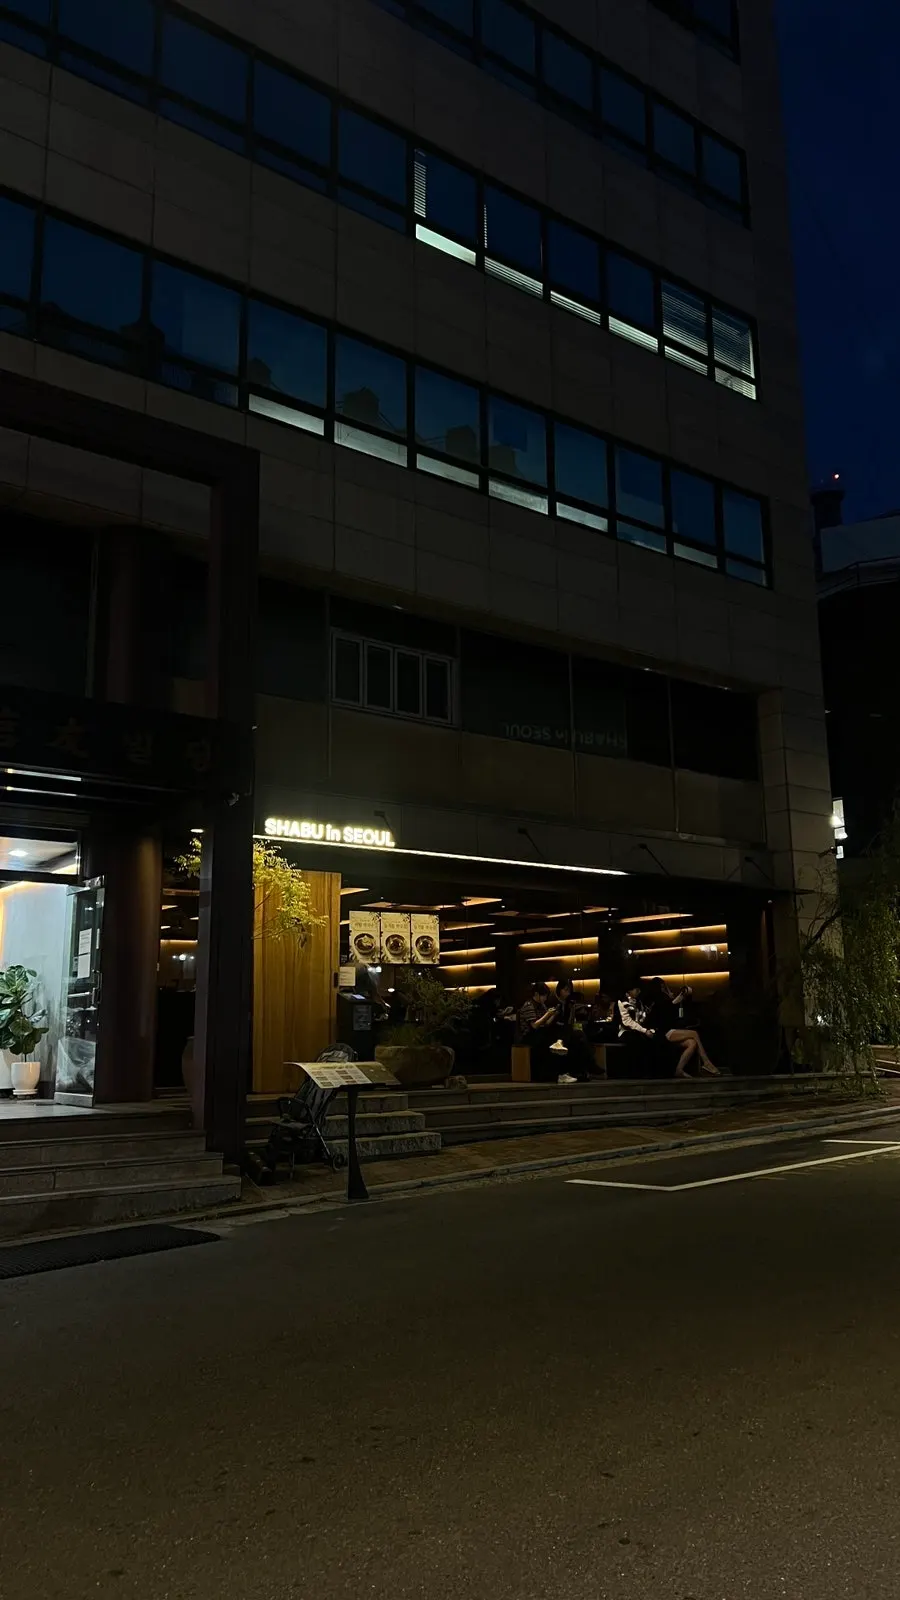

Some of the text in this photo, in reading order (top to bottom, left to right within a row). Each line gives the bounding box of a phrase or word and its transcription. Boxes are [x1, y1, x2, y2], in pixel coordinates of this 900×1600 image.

[264, 817, 395, 848] SHABU in SEOUL
